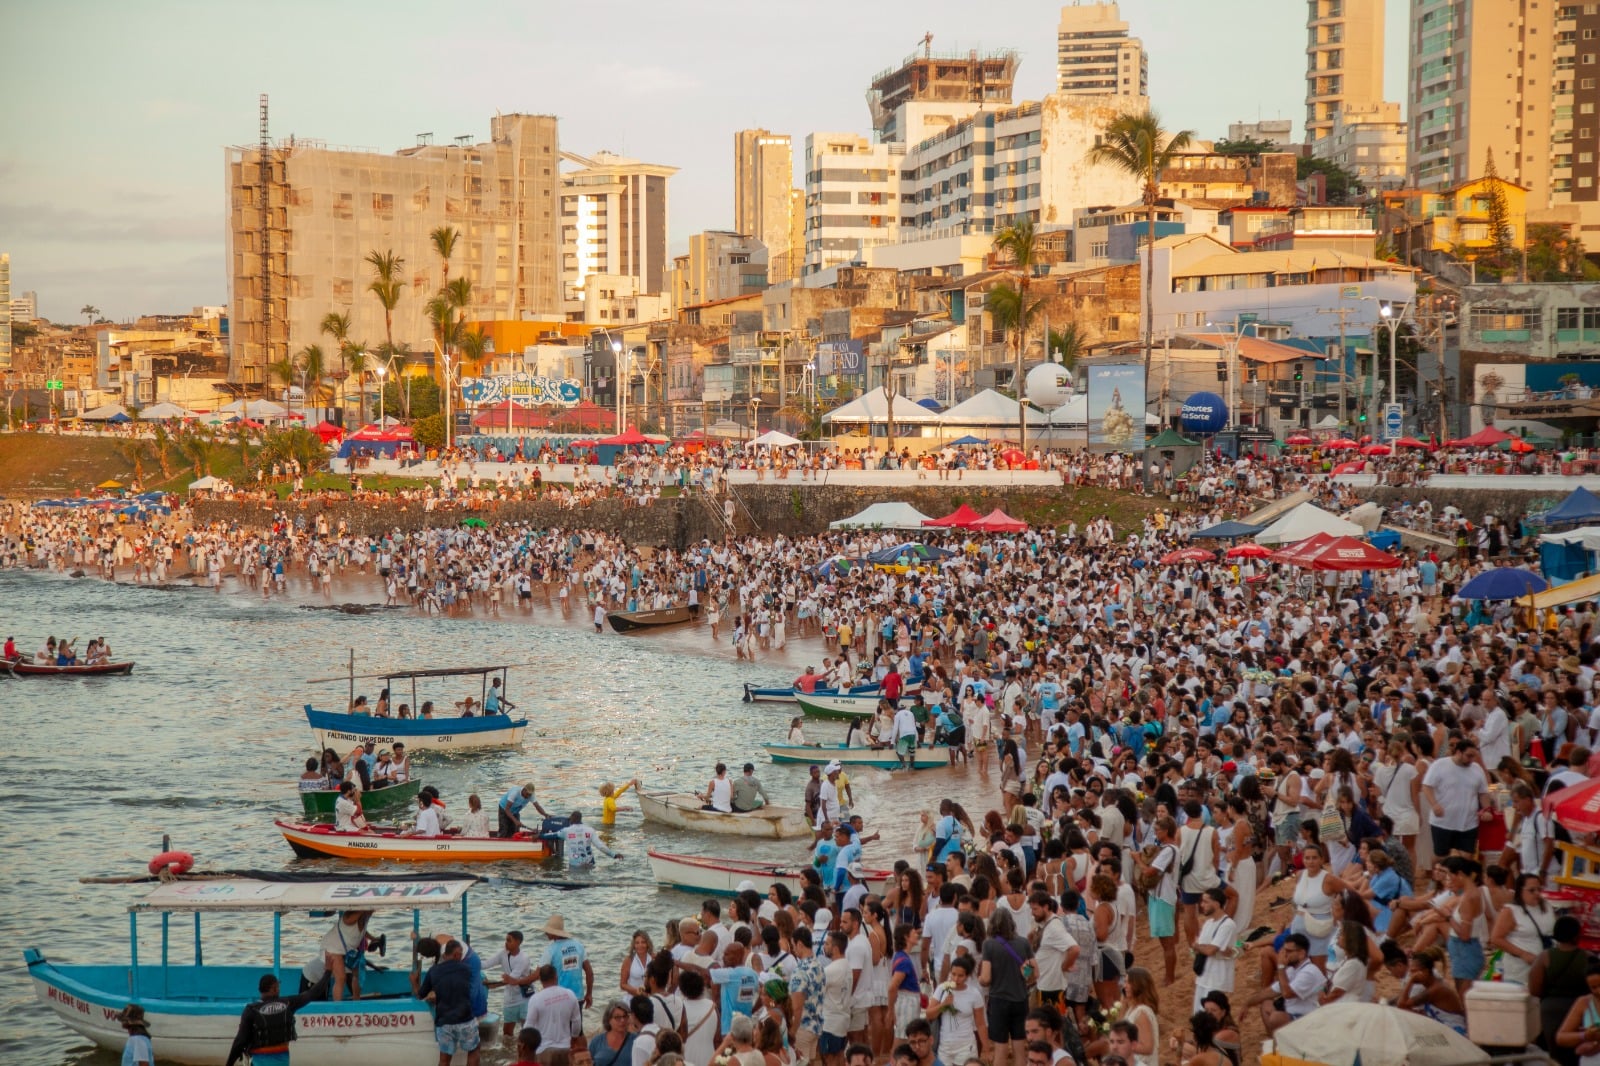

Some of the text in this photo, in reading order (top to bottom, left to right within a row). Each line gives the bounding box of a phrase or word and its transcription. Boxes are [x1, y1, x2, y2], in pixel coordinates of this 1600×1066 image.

[1182, 404, 1213, 414] Esportes
[1189, 412, 1210, 421] Sorte
[327, 731, 357, 742] FALTANDO
